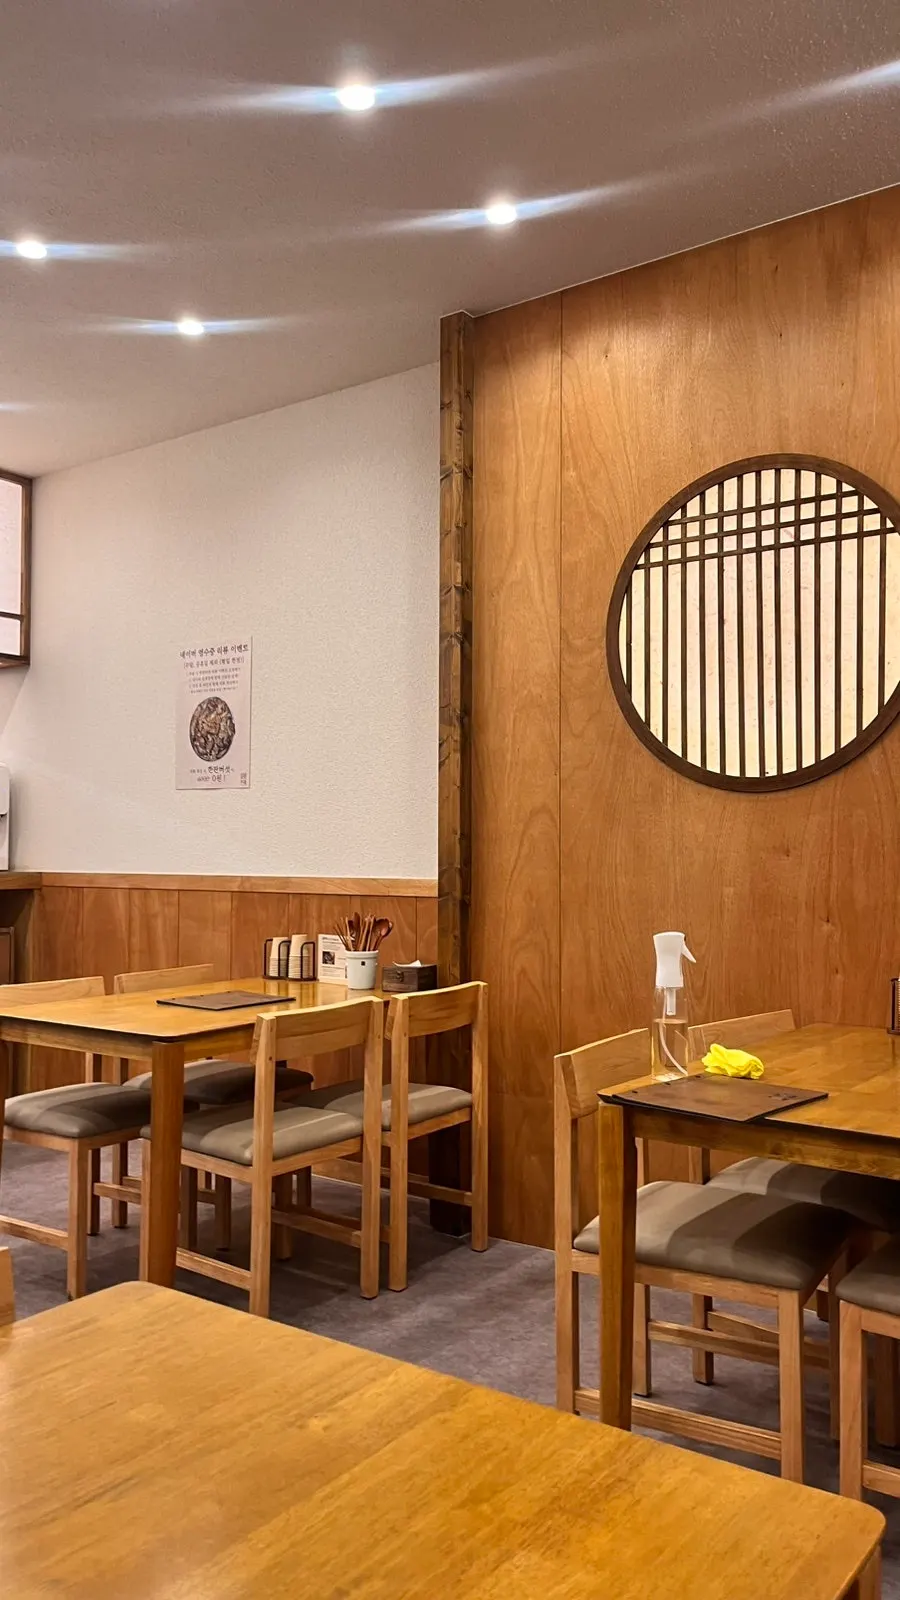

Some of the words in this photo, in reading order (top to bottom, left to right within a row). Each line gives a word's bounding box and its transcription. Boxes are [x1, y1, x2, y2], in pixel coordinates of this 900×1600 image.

[180, 650, 197, 659] 네이버
[198, 647, 215, 657] 영수증
[217, 646, 228, 655] 리뷰
[231, 644, 248, 653] 이벤트
